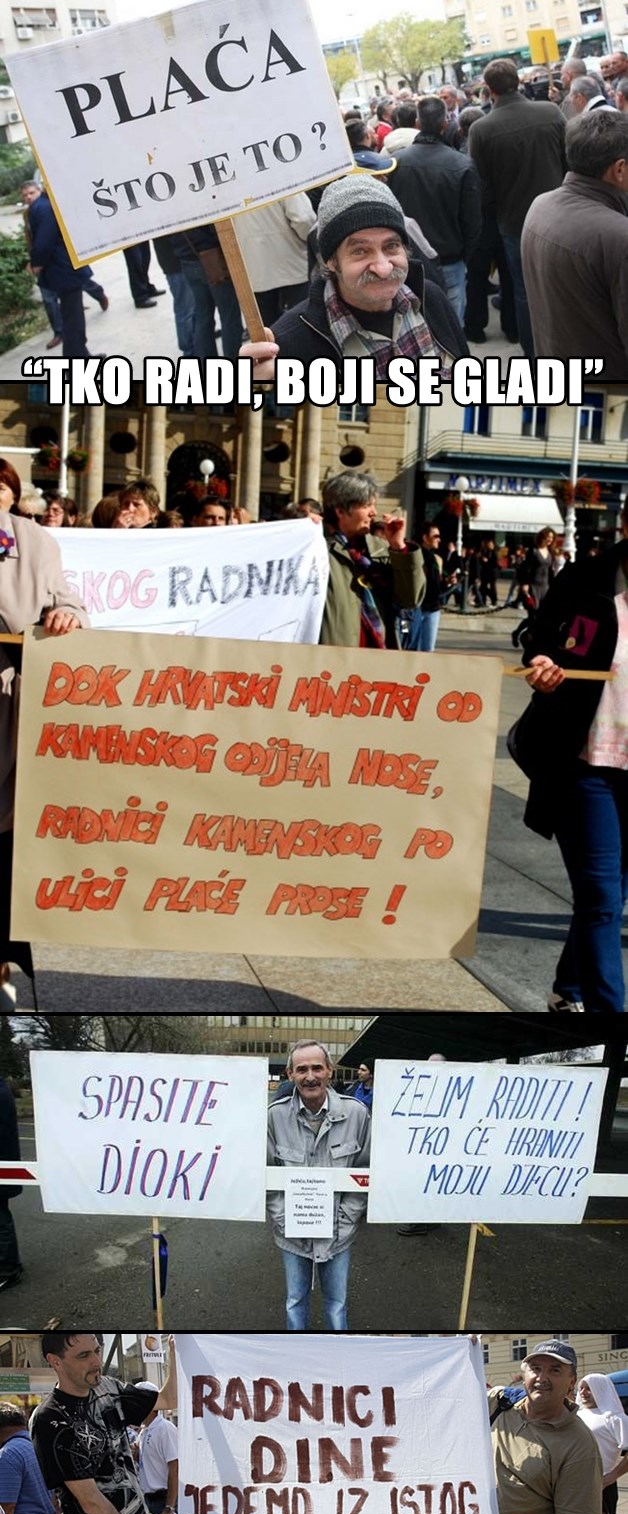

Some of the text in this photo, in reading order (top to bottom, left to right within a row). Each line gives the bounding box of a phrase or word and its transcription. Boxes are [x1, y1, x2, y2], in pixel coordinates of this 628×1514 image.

[55, 24, 307, 139] PLAĆA
[92, 121, 328, 219] ŠTO JE TO ?
[42, 662, 484, 723] DOK HRVATSKI MINISTRI OD
[35, 722, 444, 799] KAMENSKOG ODIJELA NOSE,
[35, 796, 454, 860] RADNICI KAMENSKOG PO
[35, 866, 408, 926] ULICI PLAĆE PROSE !
[78, 1073, 230, 1127] SPASITE
[391, 1066, 590, 1123] ŽELIM RADITI !
[97, 1138, 222, 1203] DIOKI
[407, 1125, 452, 1158] TKO
[505, 1128, 585, 1160] HRANITI
[423, 1164, 590, 1199] MOJU DJECU?
[192, 1375, 395, 1428] RADNICI
[250, 1436, 399, 1483] DINE
